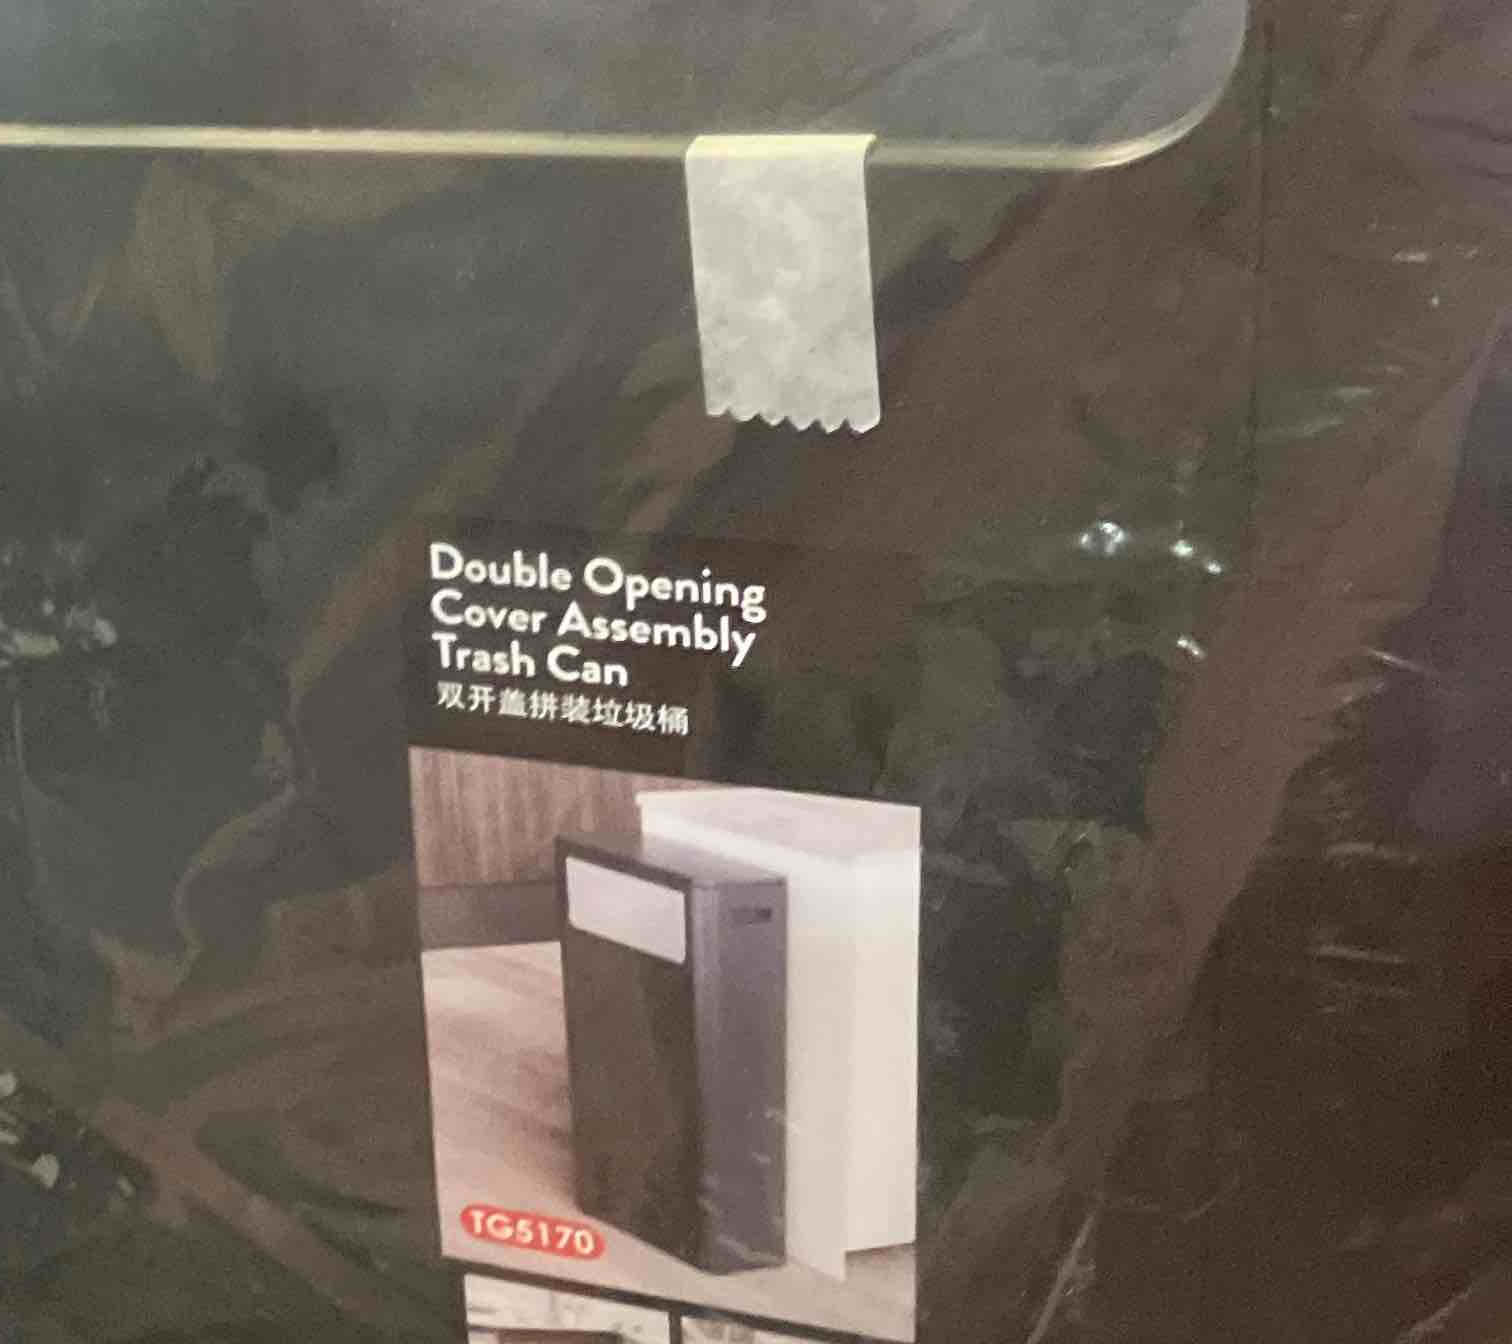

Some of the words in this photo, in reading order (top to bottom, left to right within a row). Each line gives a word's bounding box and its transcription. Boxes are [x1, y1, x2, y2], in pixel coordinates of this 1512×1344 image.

[429, 542, 573, 591] Double
[583, 557, 767, 624] Opening
[430, 589, 548, 633] Cover
[556, 600, 756, 668] Assembly
[431, 632, 536, 678] Trash
[546, 644, 629, 687] Can
[436, 680, 689, 736] 双开盖拼装垃圾桶
[470, 1209, 595, 1255] TG5170
